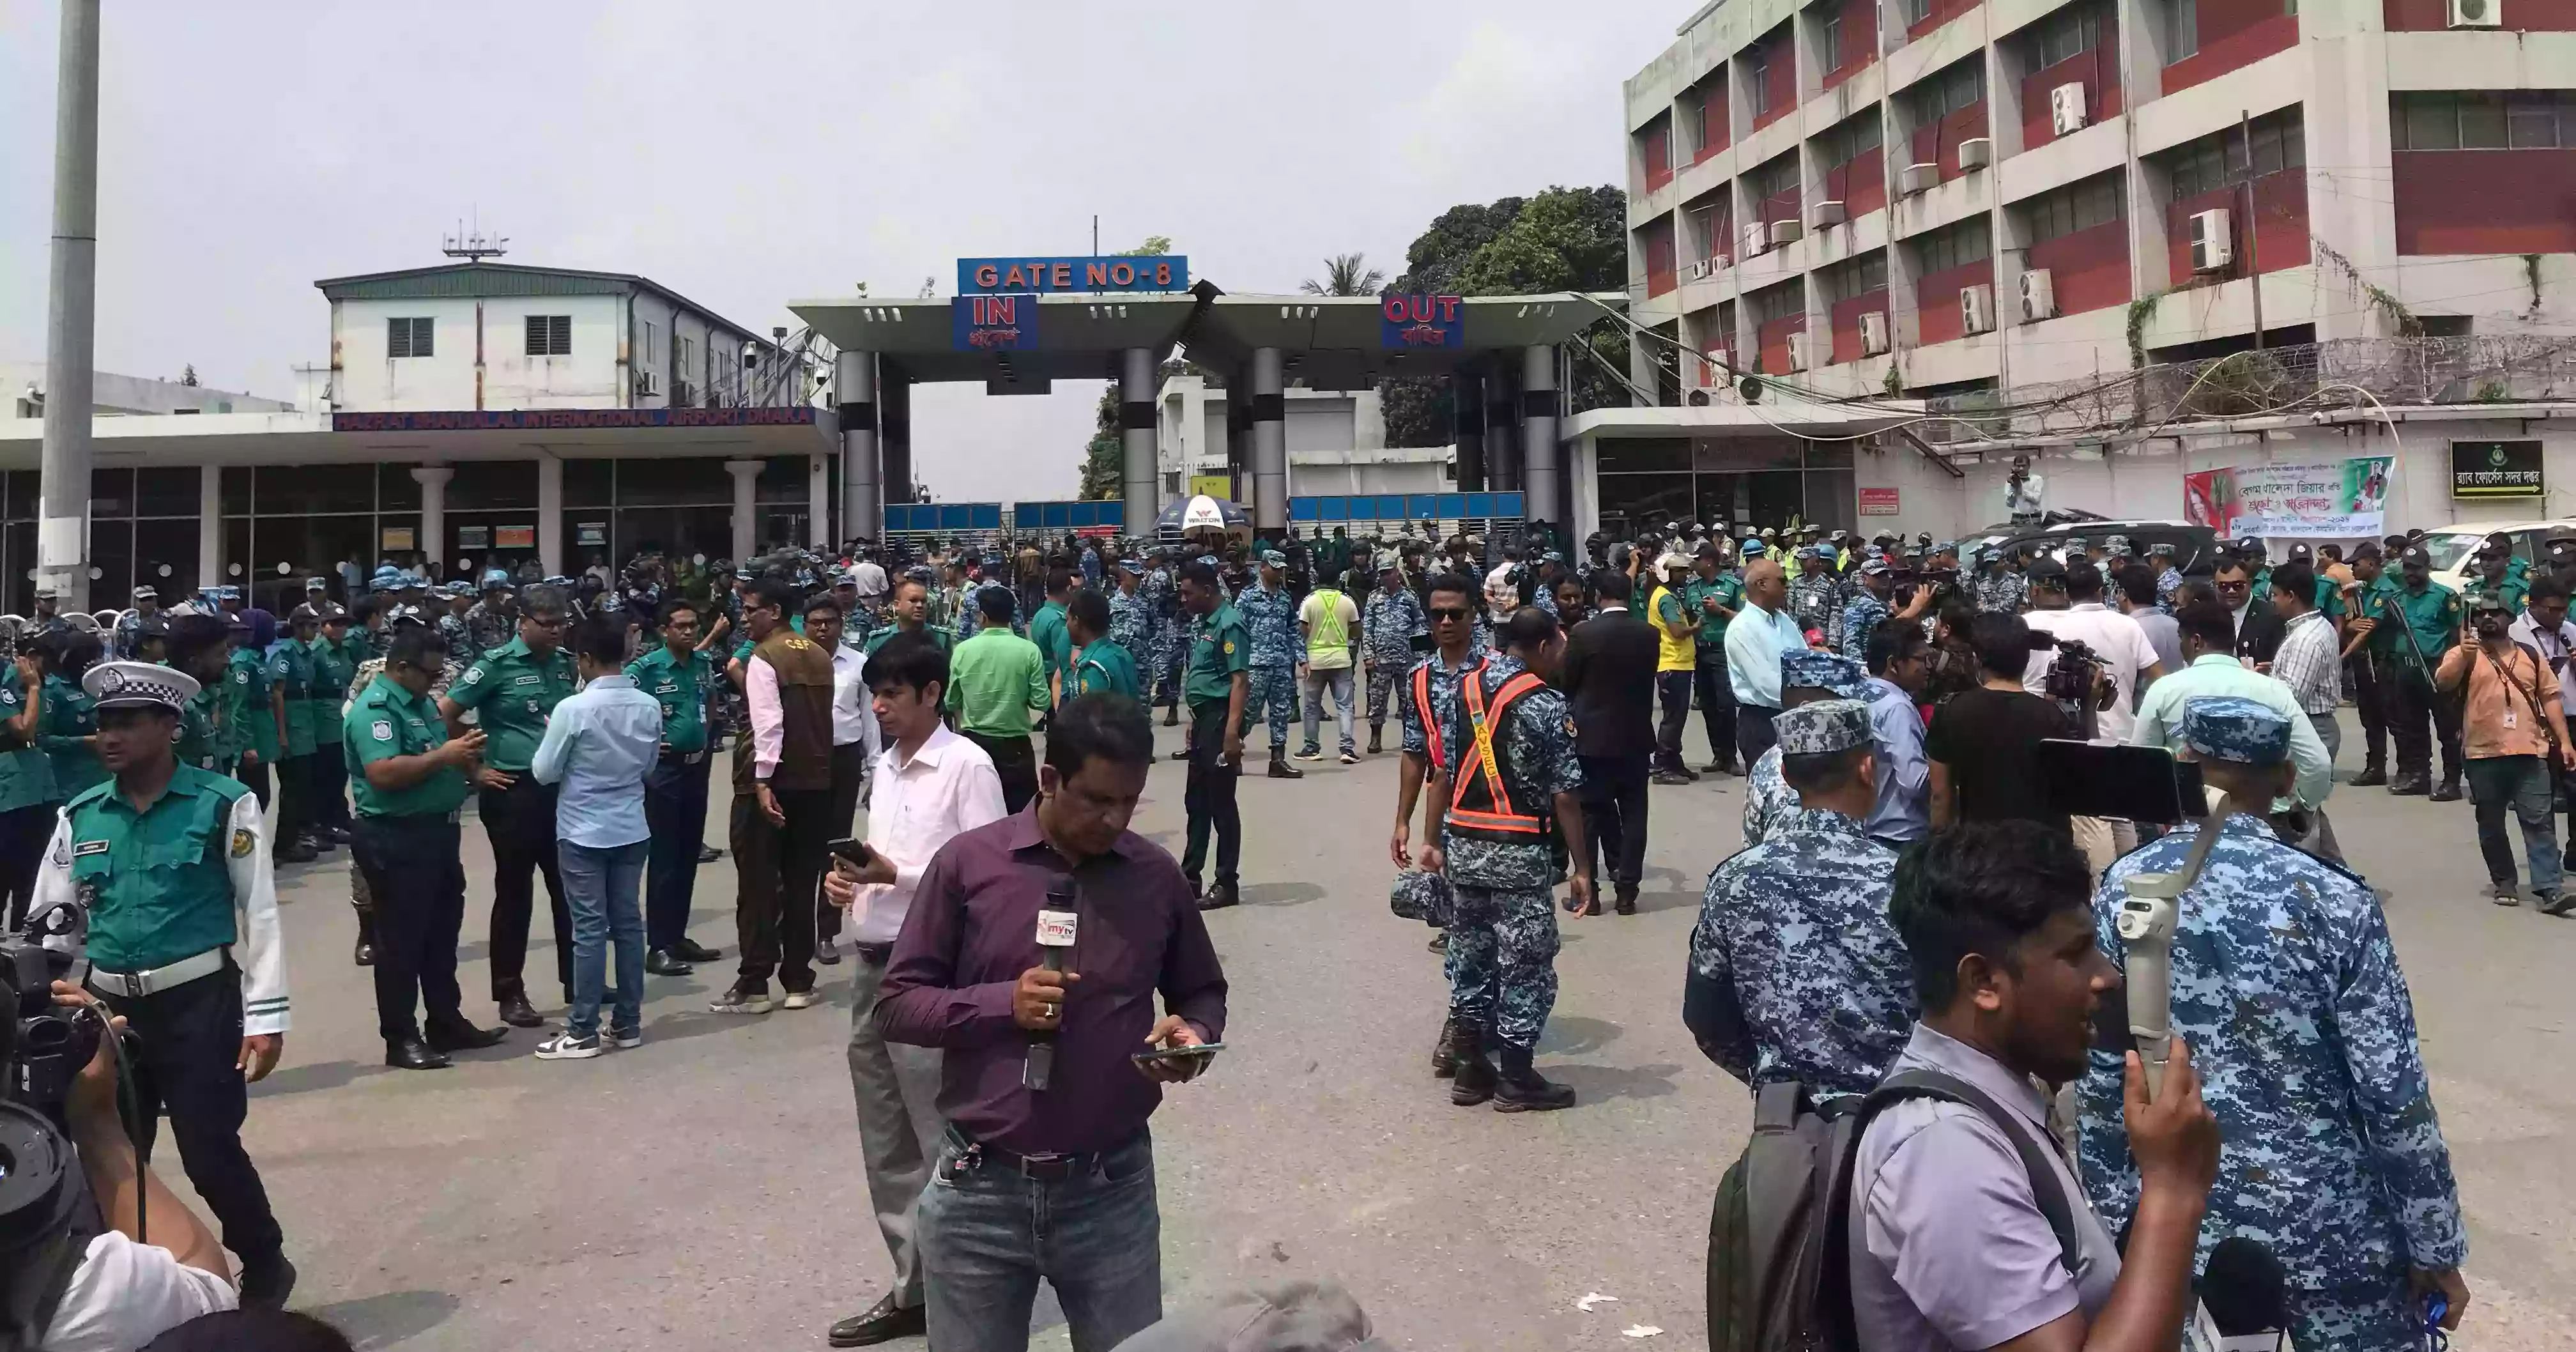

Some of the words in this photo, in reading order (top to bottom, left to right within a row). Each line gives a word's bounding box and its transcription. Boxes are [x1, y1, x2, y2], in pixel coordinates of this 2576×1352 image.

[975, 262, 1071, 287] GATE
[973, 296, 1015, 325] IN
[1384, 294, 1460, 323] OUT
[523, 411, 654, 427] INTERNATIONAL
[666, 410, 739, 425] AIRPORT
[747, 408, 807, 424] DHAKA
[2475, 468, 2503, 486] ফোর্সেস
[2504, 470, 2521, 484] সদর
[2523, 470, 2540, 484] দপ্তর
[785, 639, 810, 650] CSF
[1477, 726, 1496, 776] AVSEC
